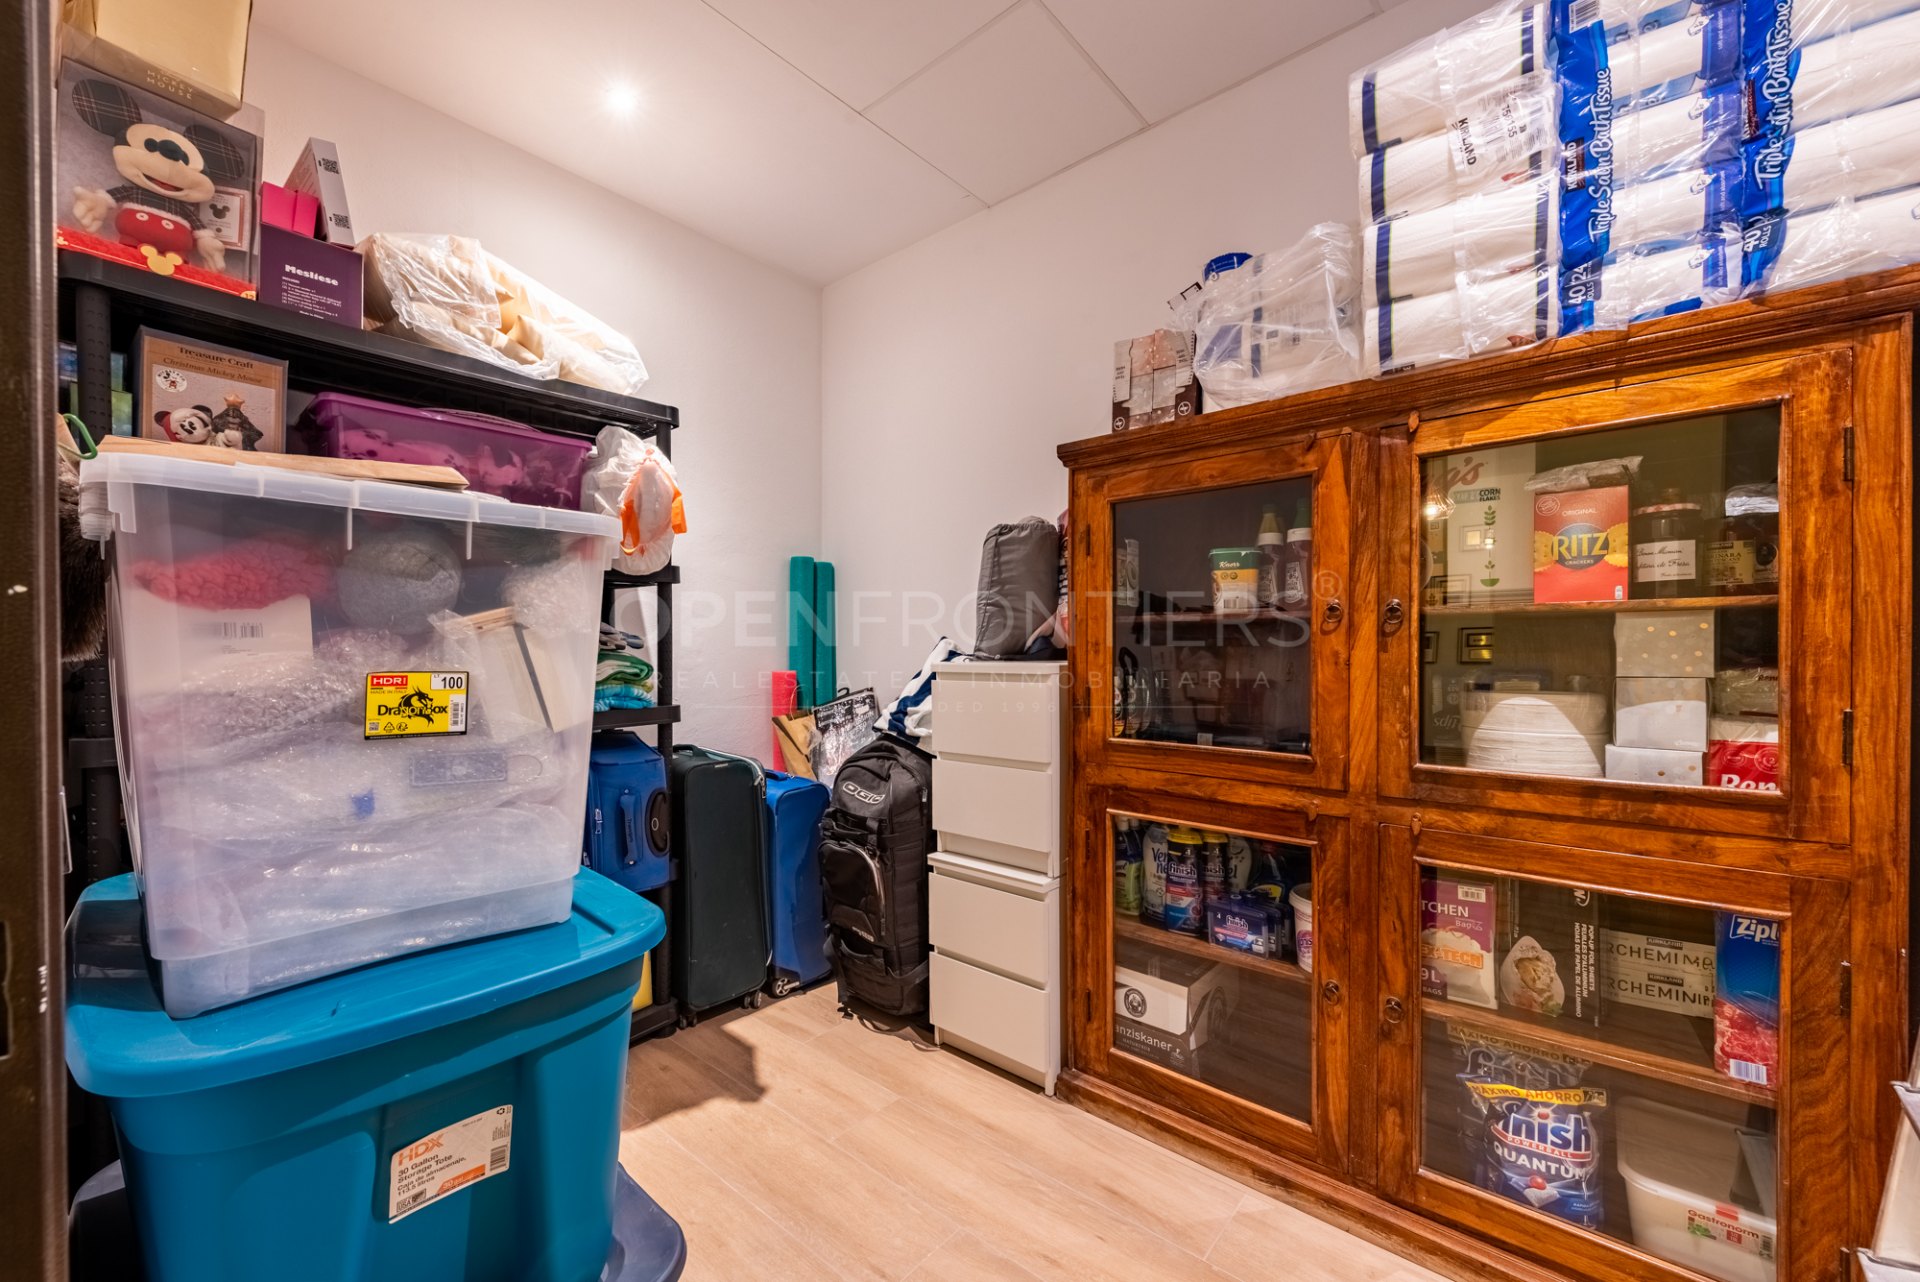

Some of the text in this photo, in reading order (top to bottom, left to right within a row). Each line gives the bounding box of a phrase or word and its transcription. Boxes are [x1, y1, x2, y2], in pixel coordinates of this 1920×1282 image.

[146, 69, 193, 93] MICKEY
[1762, 50, 1792, 101] Bath
[146, 77, 192, 100] MOUSE
[1588, 68, 1617, 243] Triple Satin Bath Tissue
[1754, 135, 1788, 190] Triple
[1743, 229, 1762, 252] 40
[1758, 225, 1772, 248] ROLLS
[284, 264, 338, 286] Mesliese
[1568, 285, 1586, 304] 40
[163, 357, 205, 372] Christmas
[208, 366, 236, 378] Mickey
[178, 346, 226, 363] Treasure
[228, 358, 254, 370] Craft
[1480, 488, 1501, 496] CORN
[1562, 508, 1598, 516] ORIGINAL
[1552, 532, 1608, 560] RITZ
[441, 676, 463, 689] 100
[378, 704, 448, 718] DragonBox
[1721, 774, 1779, 792] Ren
[1168, 862, 1197, 877] finish
[1204, 862, 1225, 875] nish
[1421, 900, 1469, 918] TCHEN
[1226, 914, 1248, 929] finish
[1736, 918, 1779, 943] Zipl
[1422, 986, 1442, 996] BAGS
[1526, 1090, 1582, 1103] AHORRO
[398, 1132, 444, 1166] HDX
[1508, 1136, 1573, 1159] POWERBALL
[398, 1154, 438, 1177] 30 Gallon
[398, 1154, 452, 1184] Storage Tote
[1493, 1142, 1586, 1180] QUANTUM
[398, 1180, 414, 1190] Caja
[1688, 1209, 1760, 1240] Gastronorm
